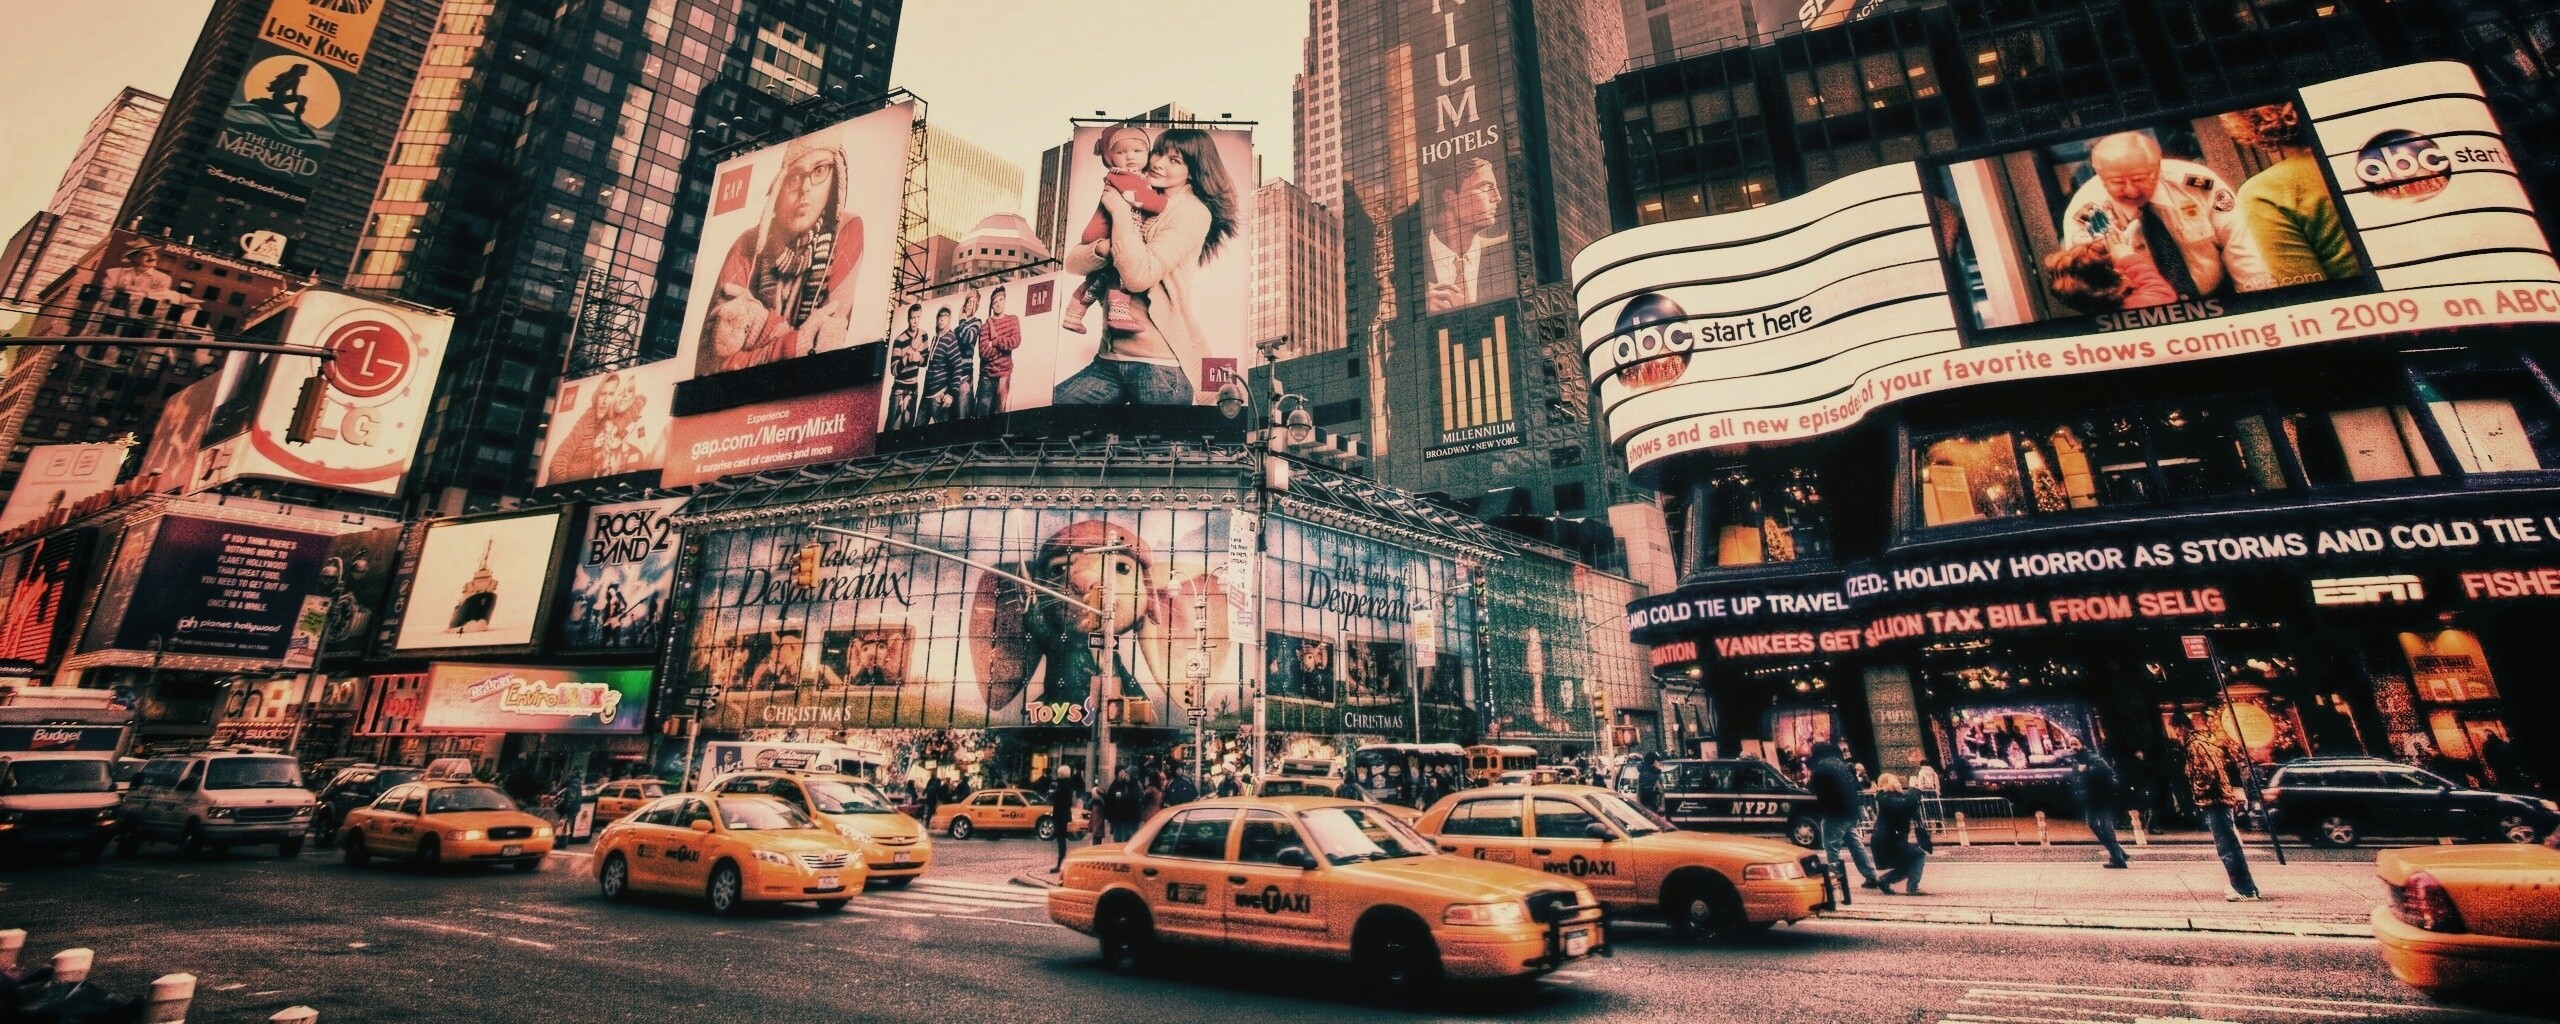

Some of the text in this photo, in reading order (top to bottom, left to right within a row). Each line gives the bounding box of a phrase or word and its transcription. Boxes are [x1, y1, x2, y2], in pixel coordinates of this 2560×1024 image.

[307, 14, 339, 36] THE
[265, 17, 359, 66] LION KING
[217, 131, 318, 176] MERMAID
[245, 132, 304, 156] THE LITTLE
[1422, 125, 1499, 165] HOTELS
[2356, 146, 2504, 182] abc start
[207, 164, 307, 203] DisneyOnBroadway.com
[723, 180, 743, 201] GAP
[165, 244, 283, 280] 100% Colombian Coffee
[2242, 271, 2322, 291] abc.com
[1032, 291, 1047, 306] GAP
[2095, 299, 2225, 332] SIEMENS
[1614, 306, 1812, 365] abc start here
[1667, 423, 1701, 447] and
[1709, 419, 1734, 439] all
[1743, 417, 1788, 435] new
[1799, 397, 1861, 433] episode
[1862, 379, 1874, 403] of
[1882, 368, 1933, 401] your
[1943, 350, 2052, 381] favorite
[2063, 340, 2156, 366] shows
[2166, 323, 2281, 355] coming
[2289, 314, 2322, 339] in
[2331, 299, 2420, 331] 2009
[2444, 298, 2484, 318] on
[747, 409, 790, 425] Experience
[691, 413, 846, 461] gap.com/MerryMixIt
[1426, 436, 1520, 459] BROADWAY NEW YORK
[1442, 422, 1516, 444] MILLENNIUM
[695, 445, 833, 474] A surprise cast of carolers and more
[587, 517, 672, 565] BAND 2
[595, 511, 655, 546] ROCK
[218, 555, 288, 570] PLANET HOLLYWOOD
[224, 545, 256, 556] NOTHING
[256, 549, 279, 558] MORE
[818, 539, 857, 568] Tale
[864, 535, 889, 574] of
[1893, 559, 2001, 592] HOLIDAY
[2011, 547, 2125, 578] HORROR
[2133, 544, 2174, 568] AS
[2183, 533, 2307, 564] STORMS
[2318, 528, 2383, 554] AND
[2391, 522, 2481, 549] COLD
[2484, 518, 2542, 543] TIE
[217, 577, 237, 587] NEED
[249, 581, 262, 589] GET
[218, 566, 236, 575] THAN
[237, 568, 261, 578] GREAT
[1332, 553, 1360, 584] The
[1362, 560, 1391, 589] Tale
[2459, 569, 2560, 600] FISHE
[223, 589, 261, 600] NEW YORK
[1306, 569, 1411, 631] Despereau
[2311, 574, 2425, 605] ESPN
[1650, 602, 1691, 624] COLD
[1694, 599, 1727, 619] TIE
[1732, 596, 1761, 616] UP
[1766, 592, 1850, 614] TRAVEL
[1715, 632, 1815, 657] YANKEES
[1819, 629, 1863, 652] GET
[1927, 608, 1984, 634] TAX
[1988, 600, 2048, 629] BILL
[2050, 594, 2132, 624] FROM
[2139, 587, 2227, 617] SELIG
[200, 620, 232, 629] planet
[234, 621, 281, 633] hollywood
[34, 729, 82, 744] Budget
[1731, 802, 1778, 815] NYPD
